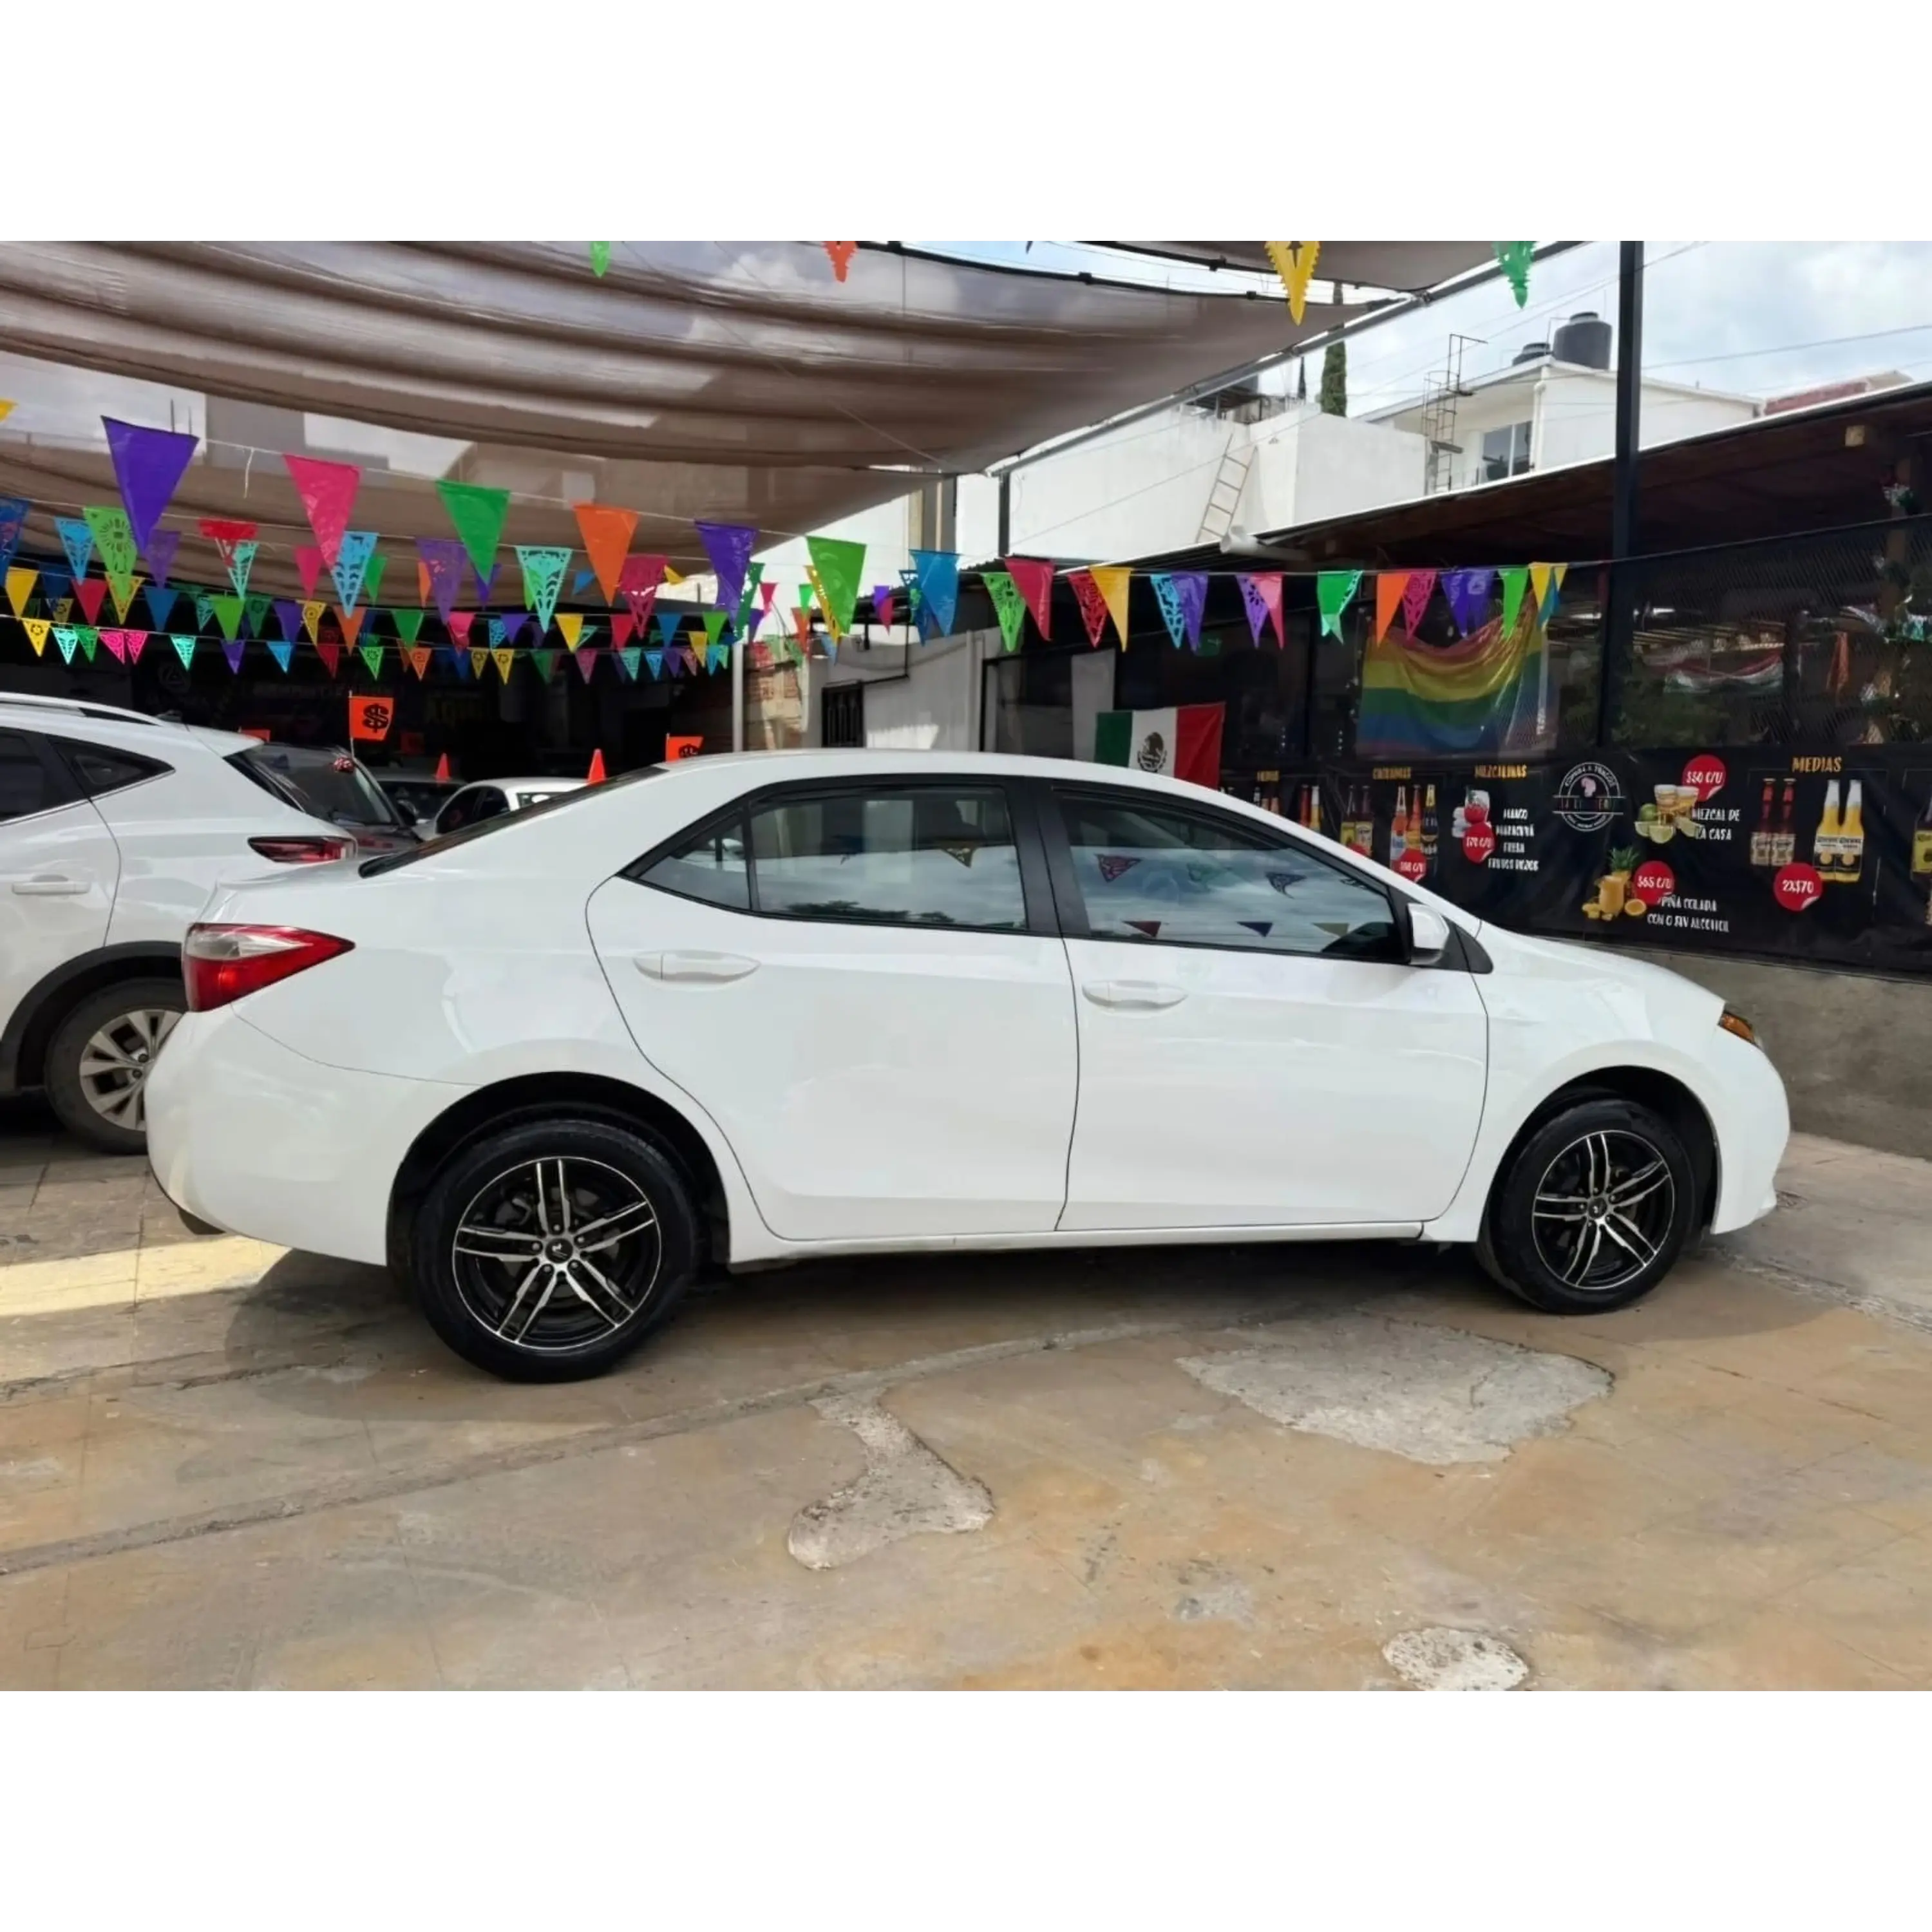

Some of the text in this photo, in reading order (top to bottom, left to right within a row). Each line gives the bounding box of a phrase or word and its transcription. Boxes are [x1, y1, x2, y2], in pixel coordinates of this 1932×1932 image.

[1792, 756, 1842, 772] MEDIAS
[1692, 808, 1740, 821] MEZCAL DE
[1709, 828, 1732, 840] CASA
[1683, 898, 1717, 912] COLADA
[1647, 913, 1665, 925] CON
[1665, 915, 1672, 926] O
[1674, 915, 1689, 927] SIN
